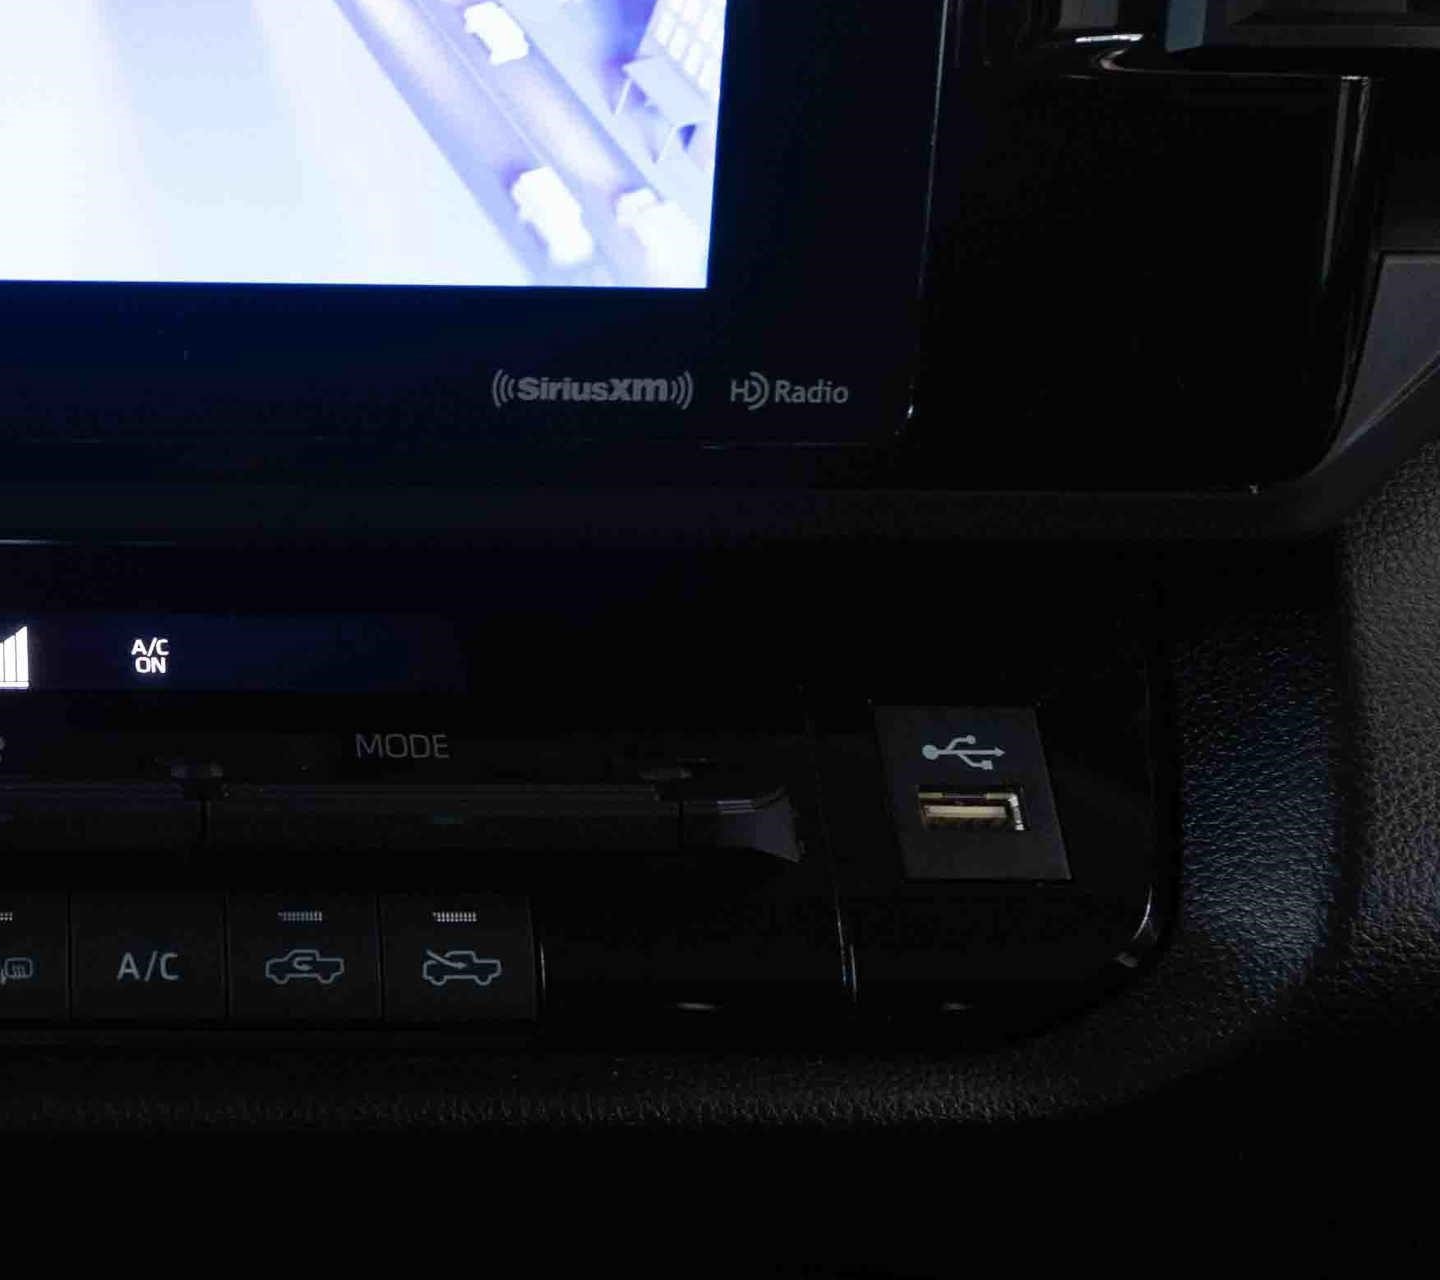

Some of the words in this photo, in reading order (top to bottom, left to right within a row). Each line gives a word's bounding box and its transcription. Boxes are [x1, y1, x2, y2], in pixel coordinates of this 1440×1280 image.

[774, 378, 849, 405] Radio
[130, 637, 170, 657] A/C
[134, 656, 168, 674] ON
[354, 733, 450, 760] MODE
[117, 951, 180, 982] A/C
